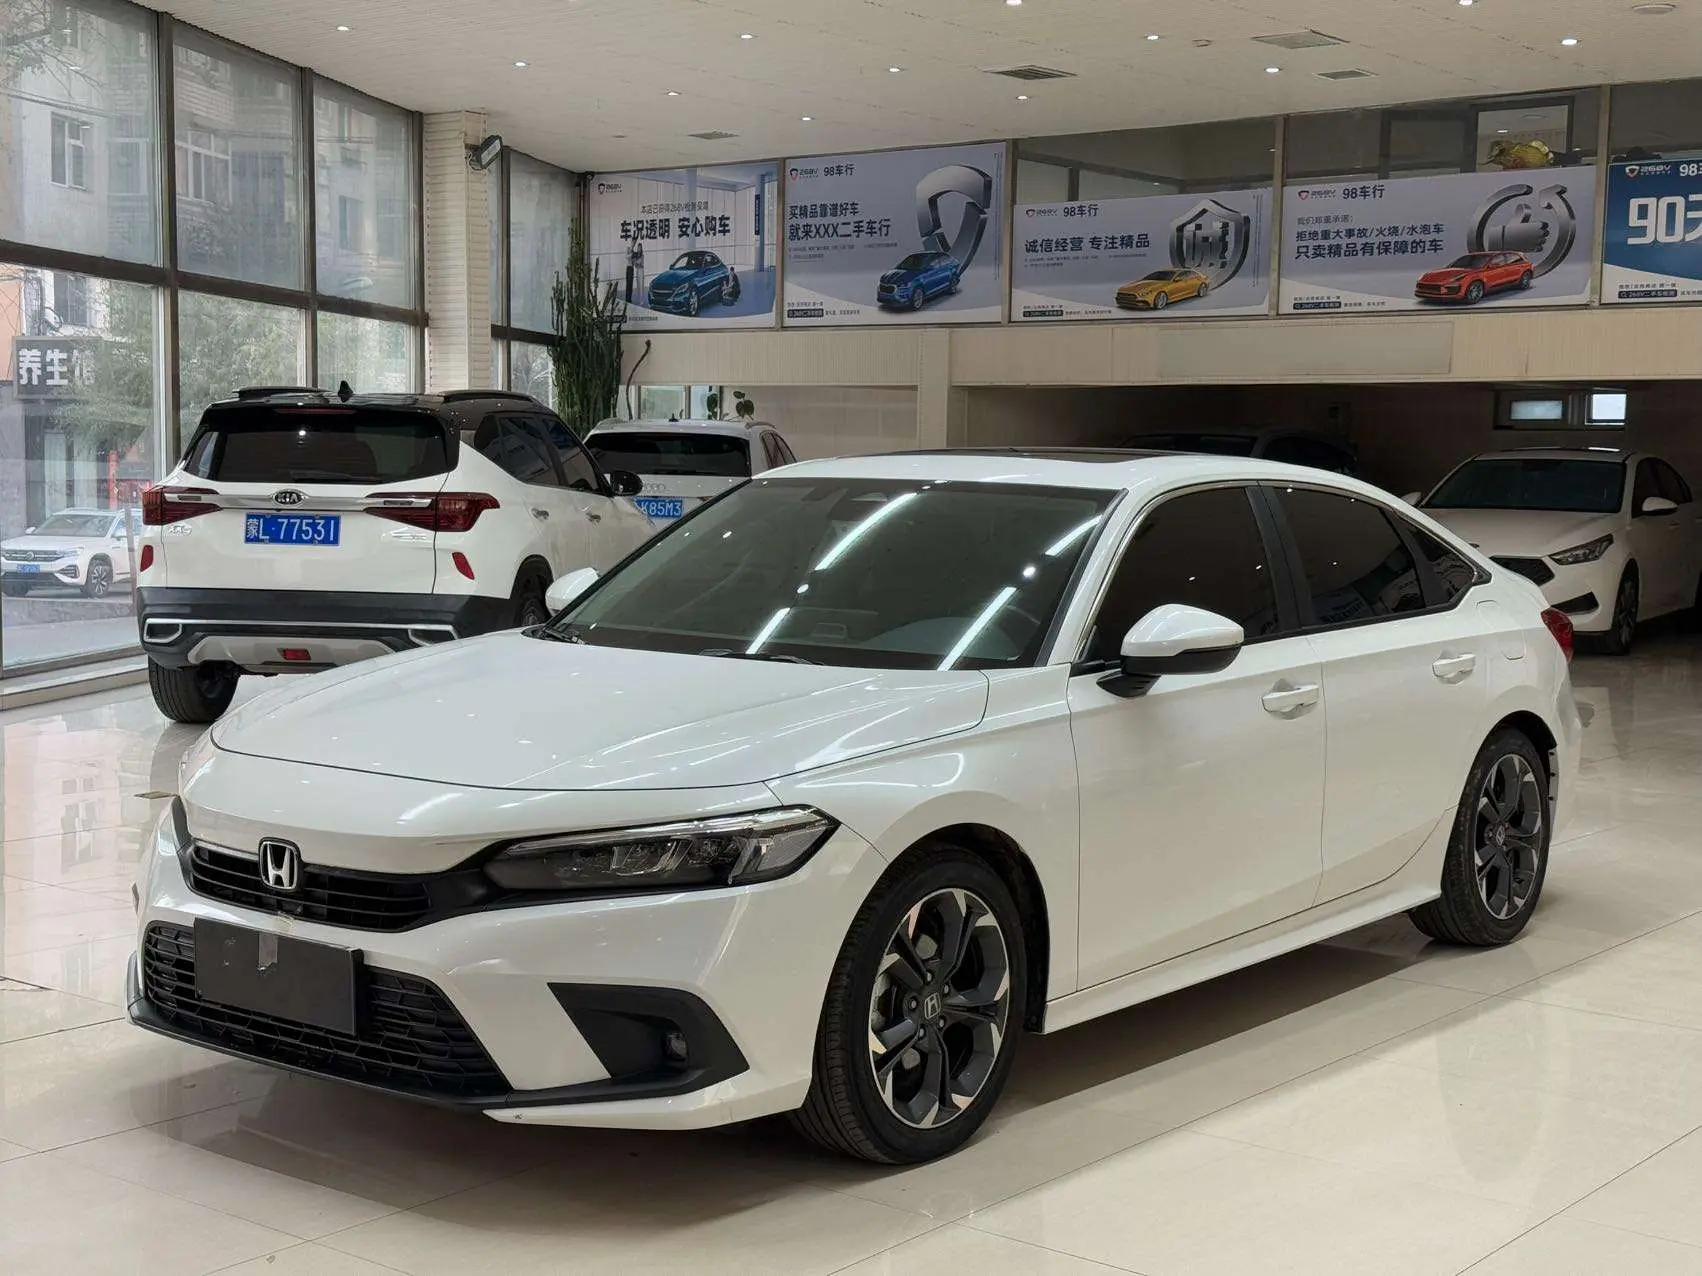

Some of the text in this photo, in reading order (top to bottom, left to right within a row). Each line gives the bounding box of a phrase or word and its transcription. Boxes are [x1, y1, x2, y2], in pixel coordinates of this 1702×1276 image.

[823, 163, 855, 177] 98车行
[1342, 184, 1385, 200] 98车行
[788, 202, 859, 220] 买精品靠谱好车
[1063, 203, 1099, 218] 98车行
[620, 219, 671, 242] 车况透明
[678, 215, 731, 237] 安心购车
[789, 218, 891, 241] 就来XXX二手车行
[1295, 222, 1445, 242] 拒绝重大事故/火烧/水泡车
[1024, 233, 1150, 254] 诚信经营 专注精品
[1295, 239, 1444, 260] 只卖精品有保障的车
[275, 491, 299, 504] KIA
